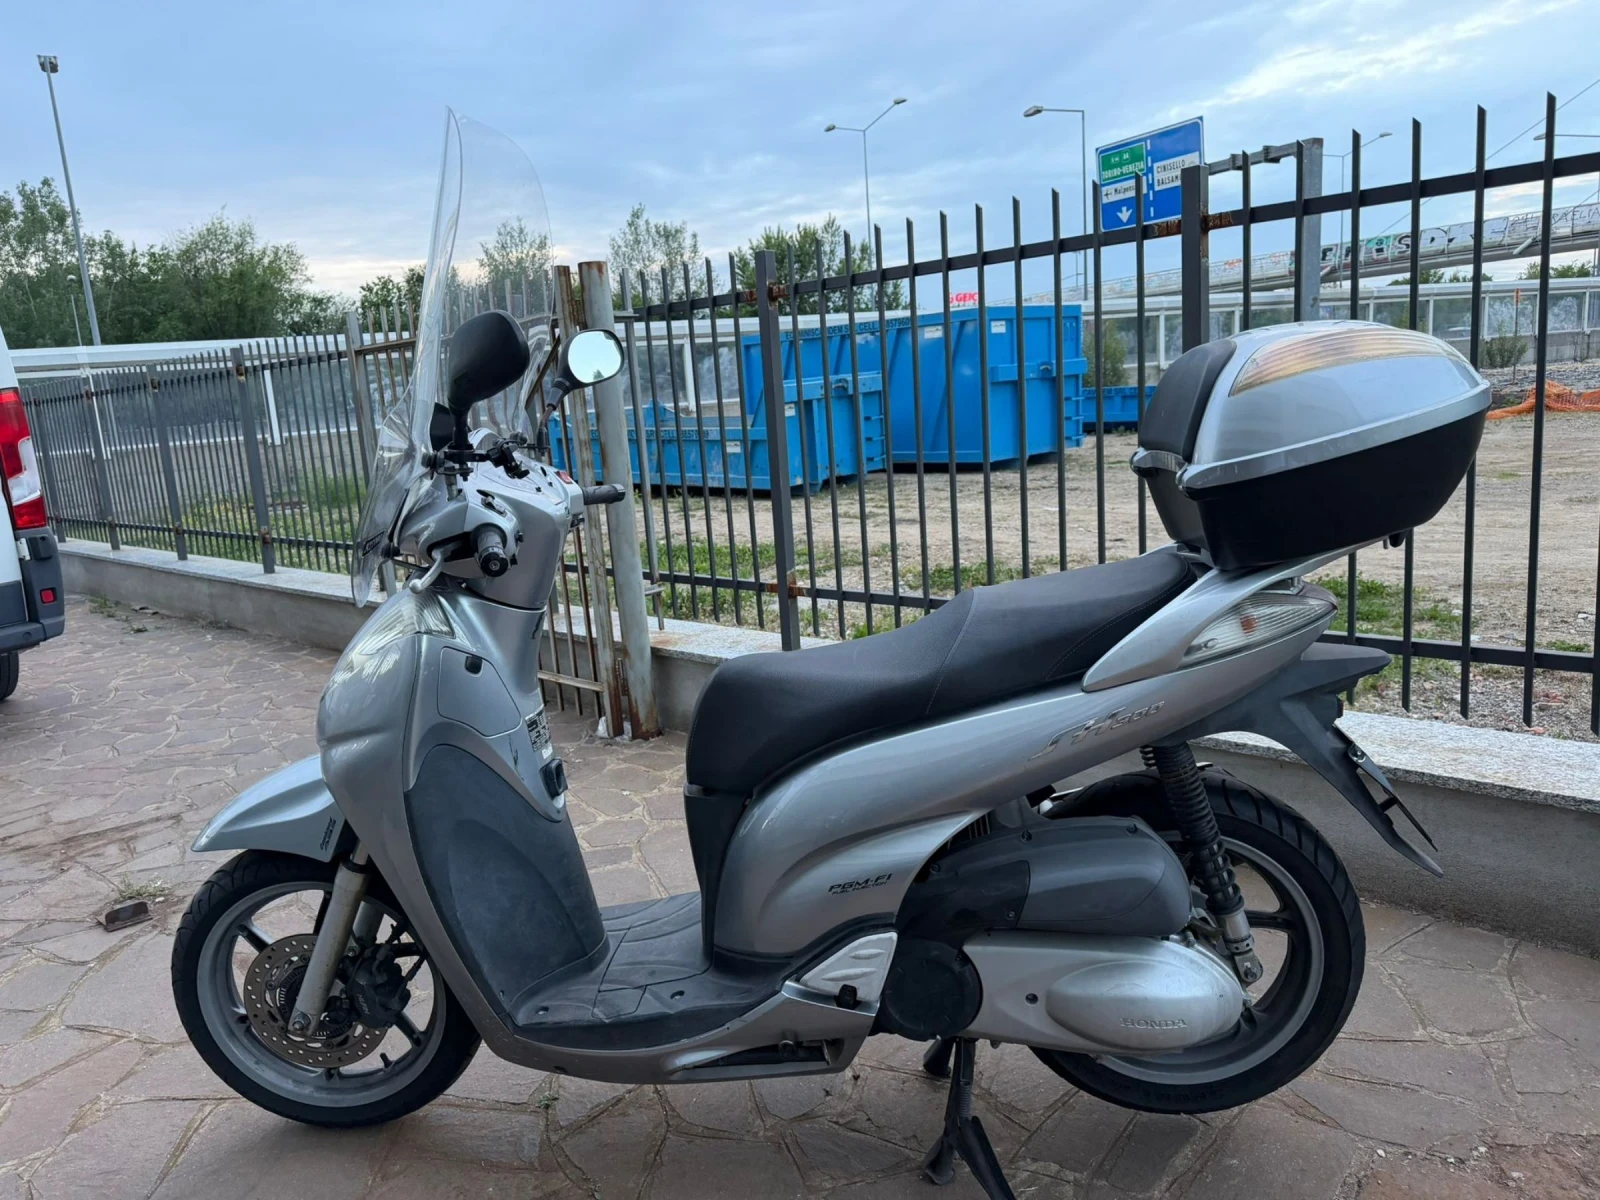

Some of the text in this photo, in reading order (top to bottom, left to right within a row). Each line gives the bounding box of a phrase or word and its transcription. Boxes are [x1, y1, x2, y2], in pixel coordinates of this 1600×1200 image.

[1156, 159, 1186, 174] CINISELLO
[1157, 174, 1180, 187] BALSAM
[1119, 1018, 1188, 1030] HONDA
